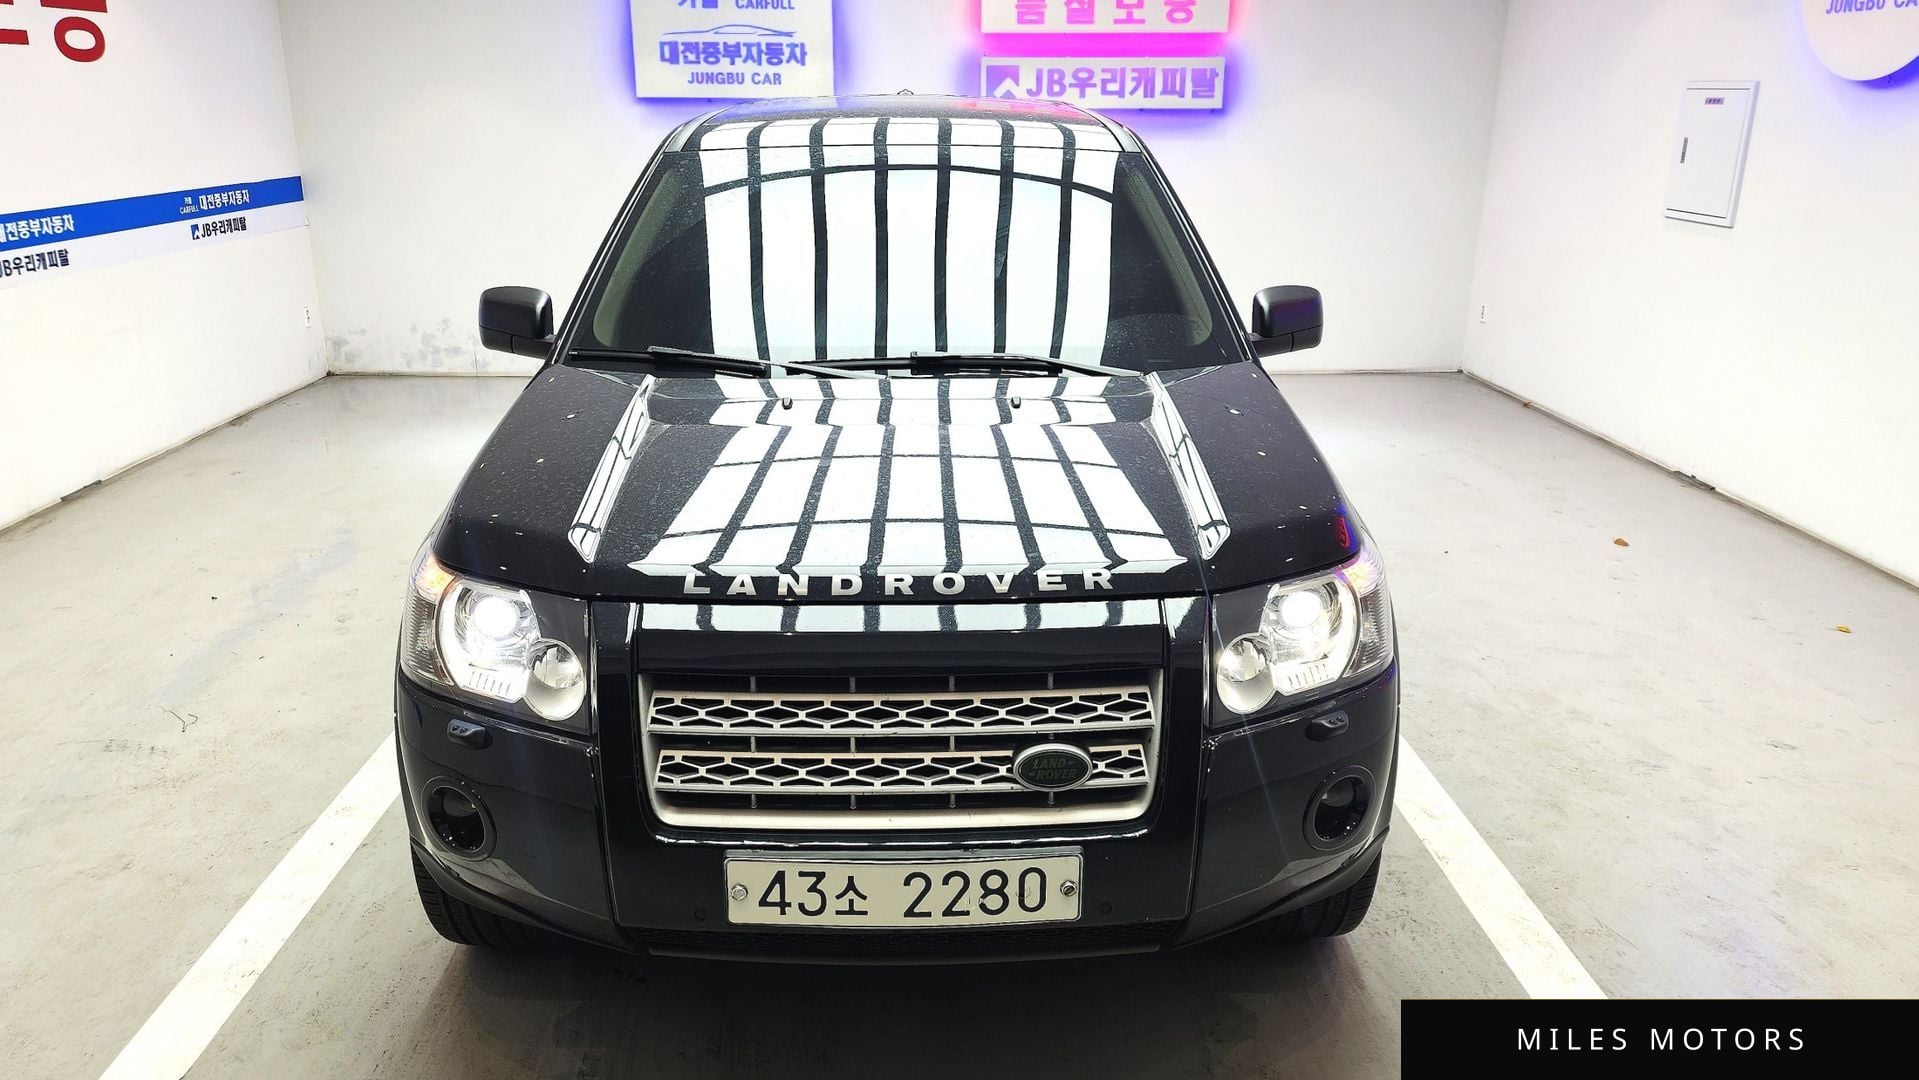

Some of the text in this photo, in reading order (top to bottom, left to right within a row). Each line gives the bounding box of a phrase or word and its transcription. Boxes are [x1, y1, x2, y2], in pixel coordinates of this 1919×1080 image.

[658, 40, 808, 67] 대전중부자동차
[687, 71, 782, 86] JUNGBU CAR
[1026, 67, 1219, 99] JB우리캐피탈
[198, 189, 250, 211] 대전중부자동차
[758, 866, 1048, 918] 43소 2280
